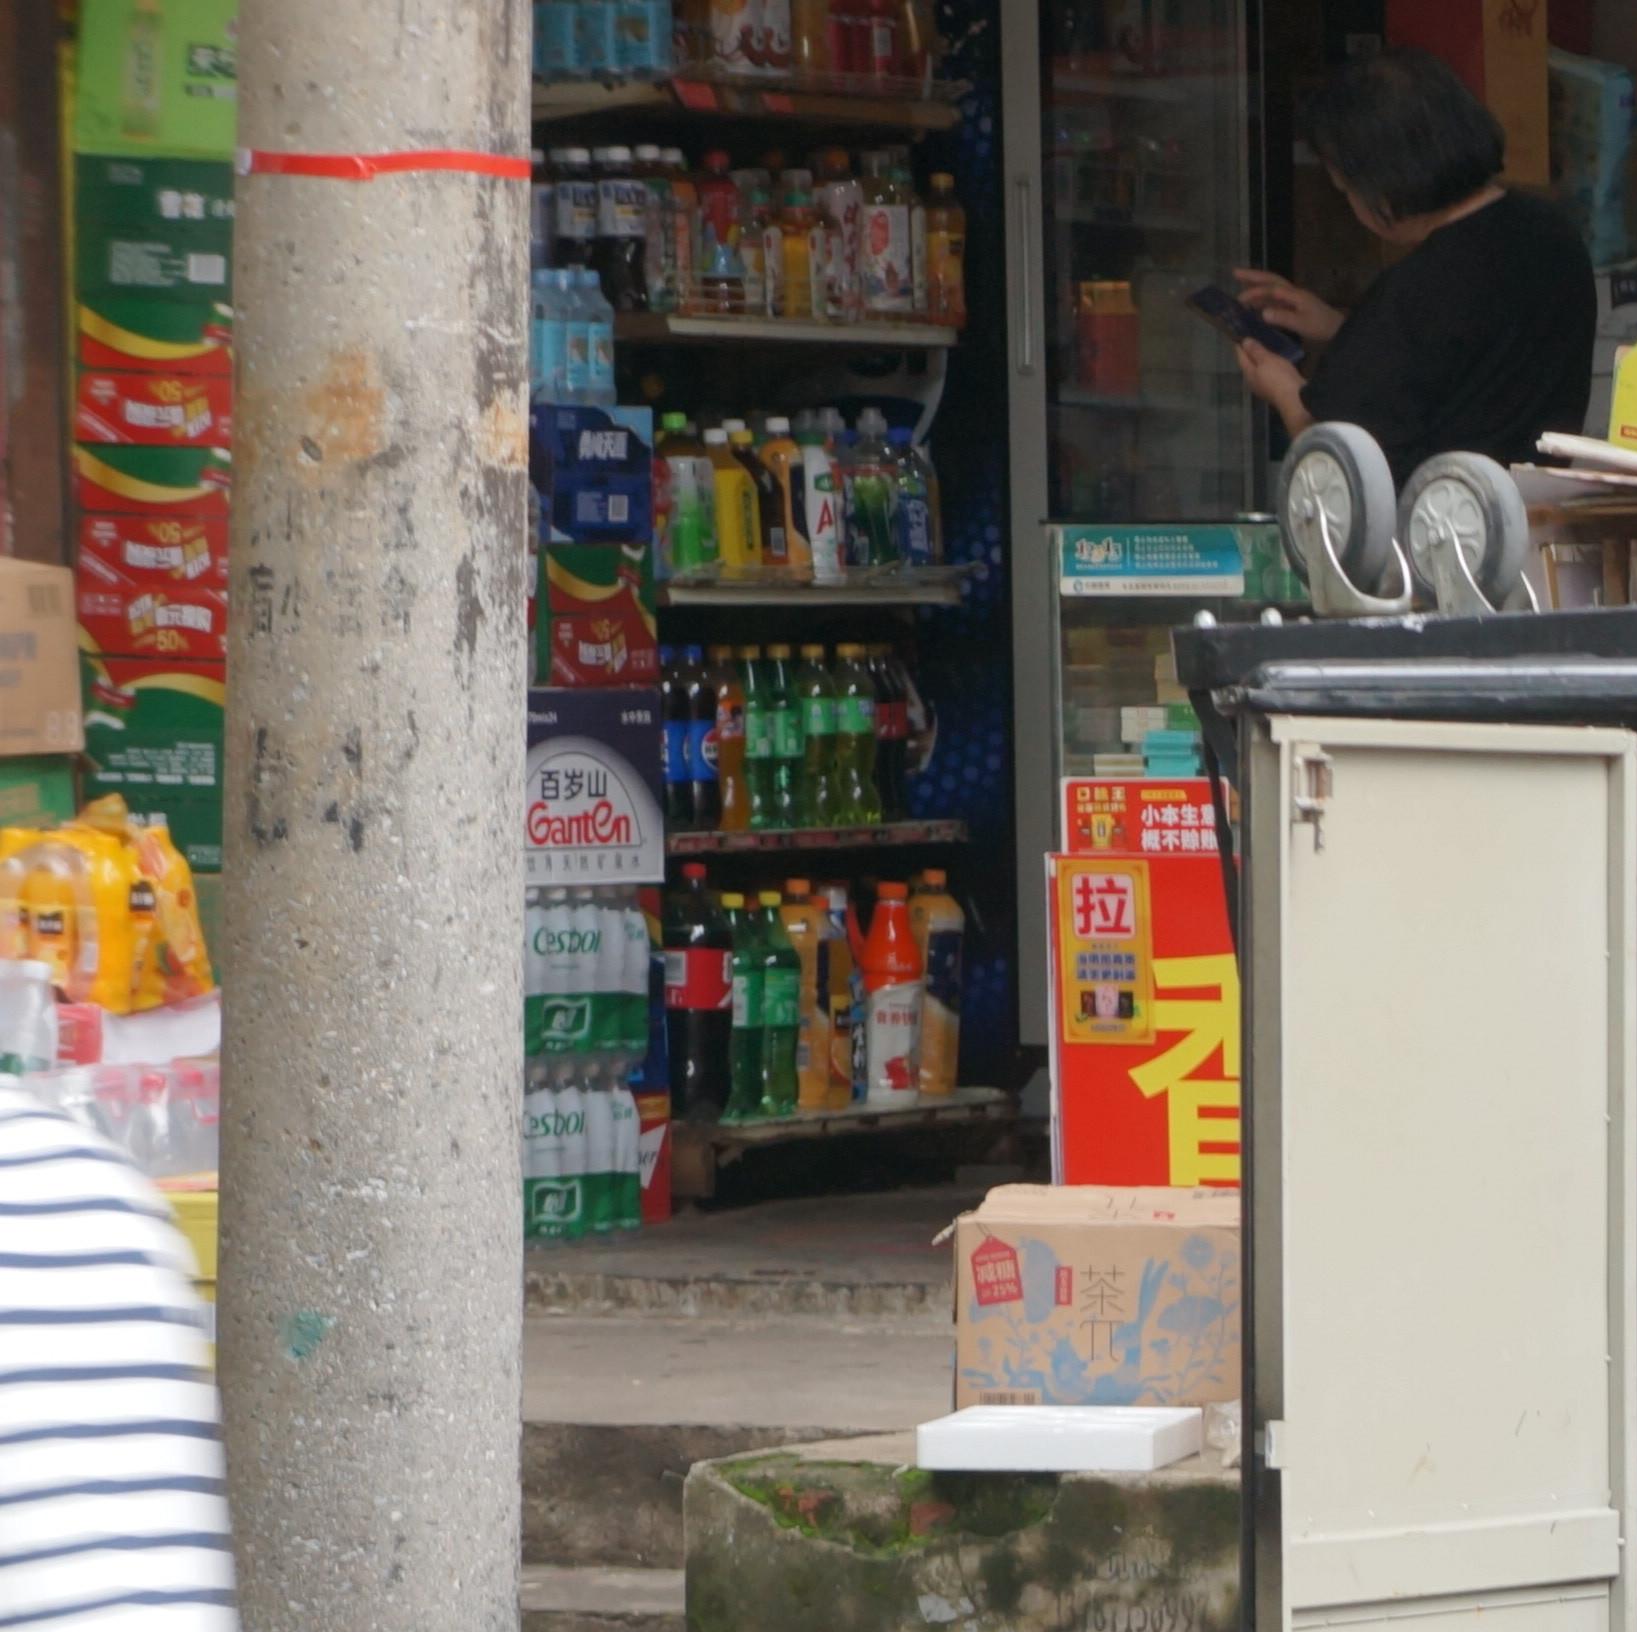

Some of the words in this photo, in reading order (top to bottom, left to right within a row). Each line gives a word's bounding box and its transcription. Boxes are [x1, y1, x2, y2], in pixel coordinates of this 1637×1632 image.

[541, 769, 607, 800] 百岁山
[528, 800, 631, 846] Ganten
[1075, 876, 1132, 935] 拉
